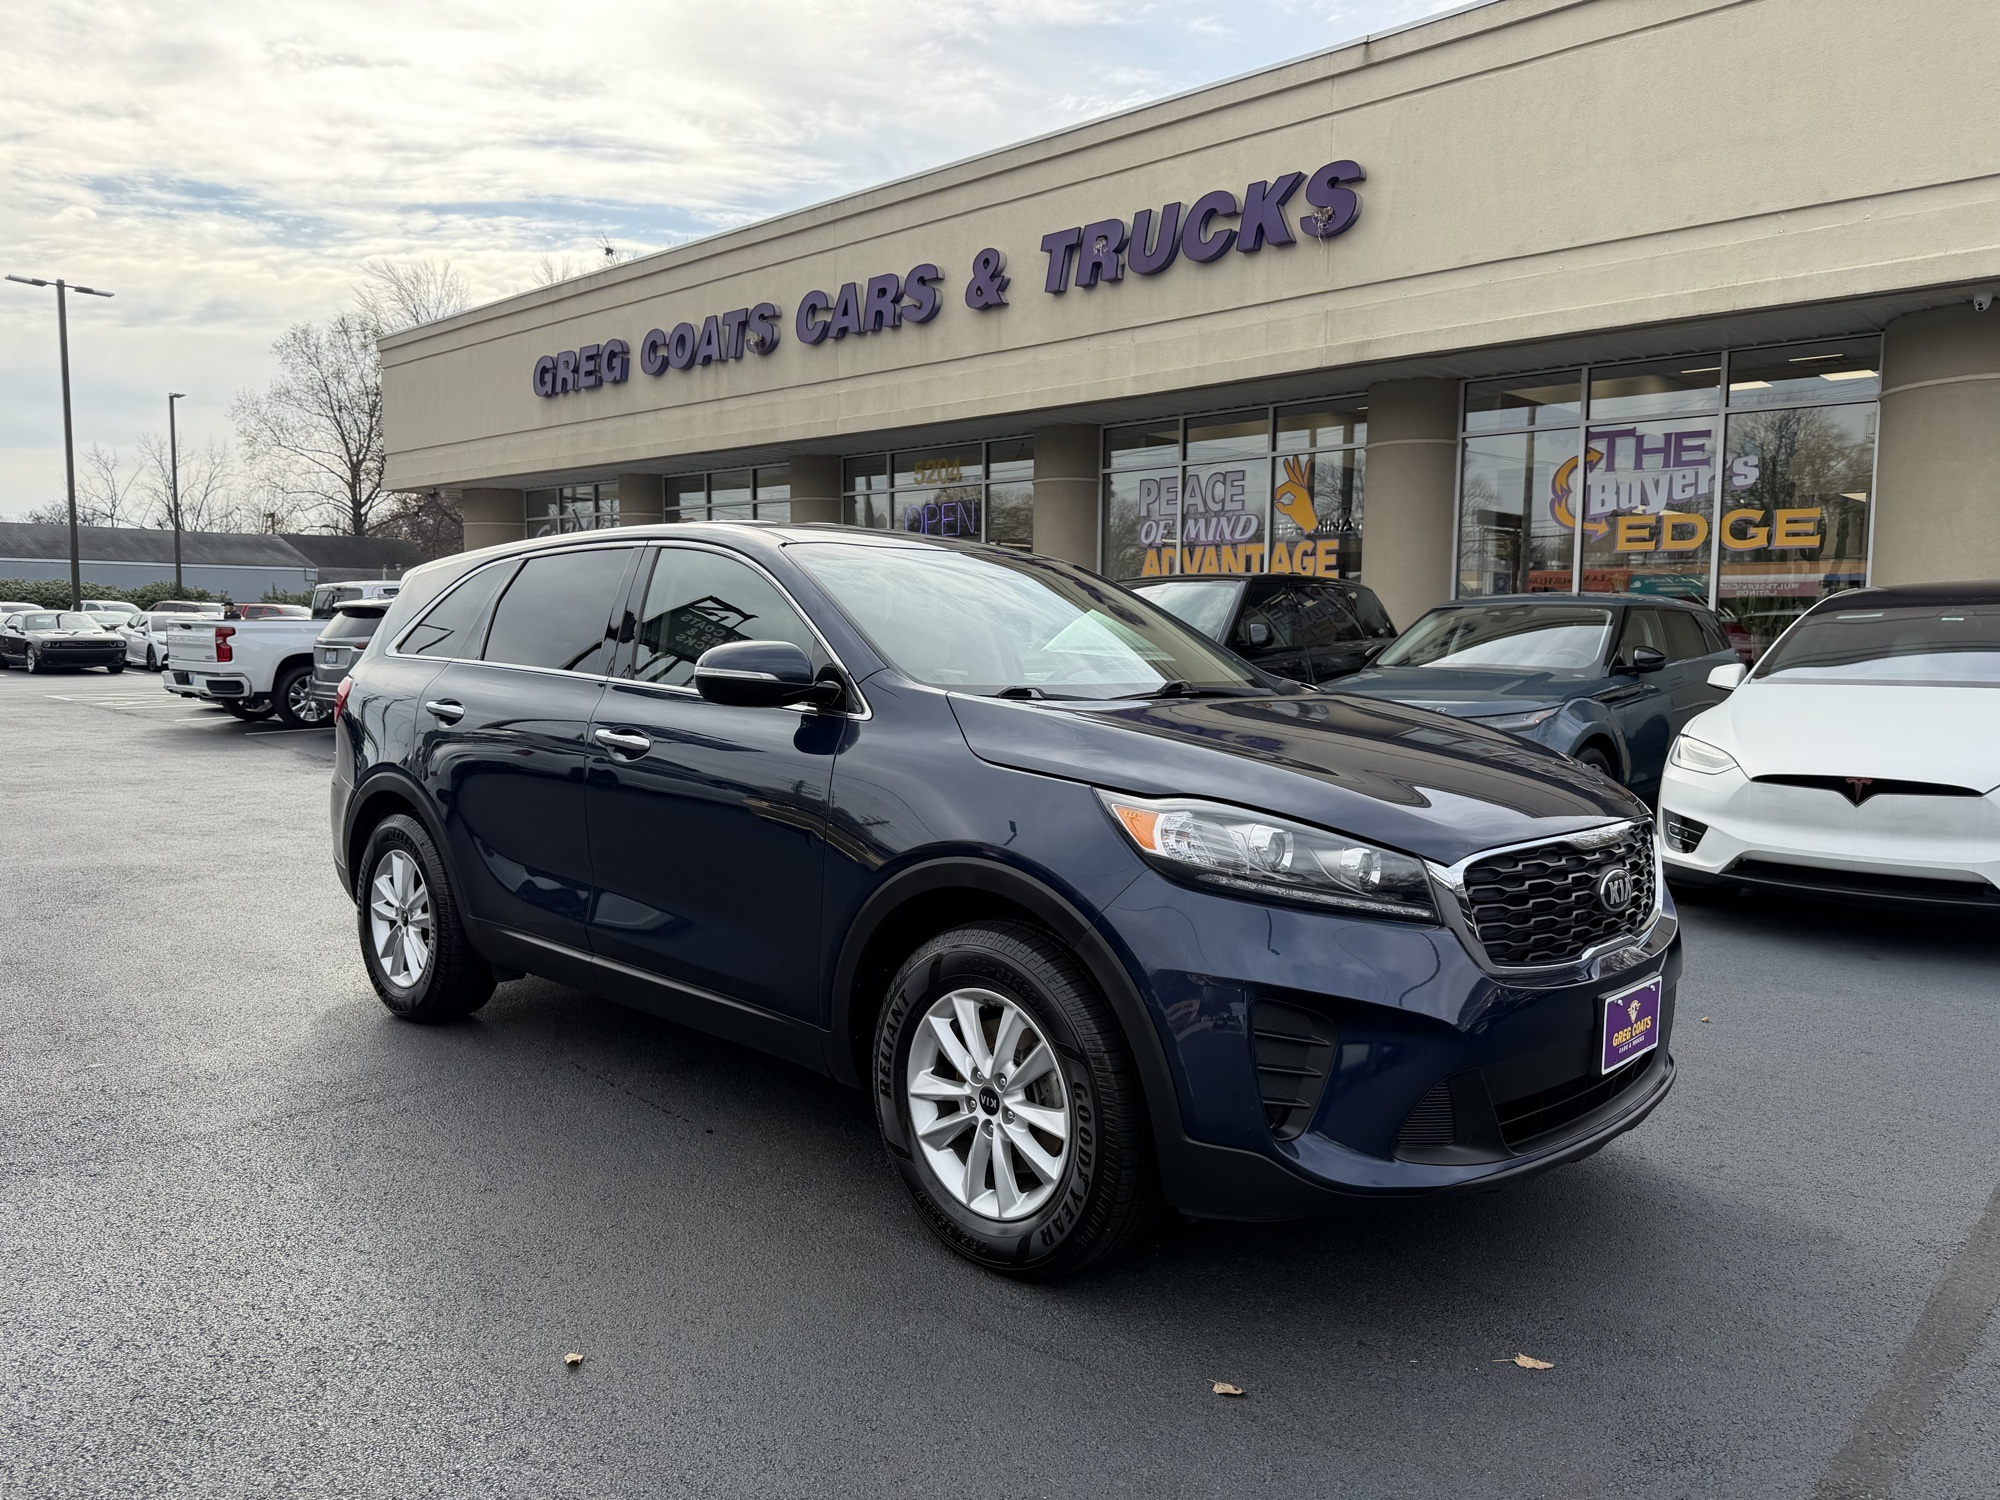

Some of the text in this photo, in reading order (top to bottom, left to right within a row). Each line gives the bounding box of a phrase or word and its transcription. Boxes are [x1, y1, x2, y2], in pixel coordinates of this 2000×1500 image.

[533, 159, 1367, 397] GREG COATS CARS & TRUCKS
[1589, 427, 1712, 473] THE
[913, 457, 962, 485] 5204
[1139, 470, 1245, 517] PEACE
[904, 500, 975, 536] OPEN
[1139, 514, 1259, 547] OF MIND
[1615, 506, 1821, 553] EDGE
[1140, 539, 1340, 579] ADVANTAGE
[1608, 878, 1632, 904] KIA
[880, 988, 910, 1099] RELIANT
[1612, 1016, 1652, 1047] GREG COATS
[980, 1093, 997, 1108] KIA
[1041, 1082, 1093, 1247] GOODYEAR
